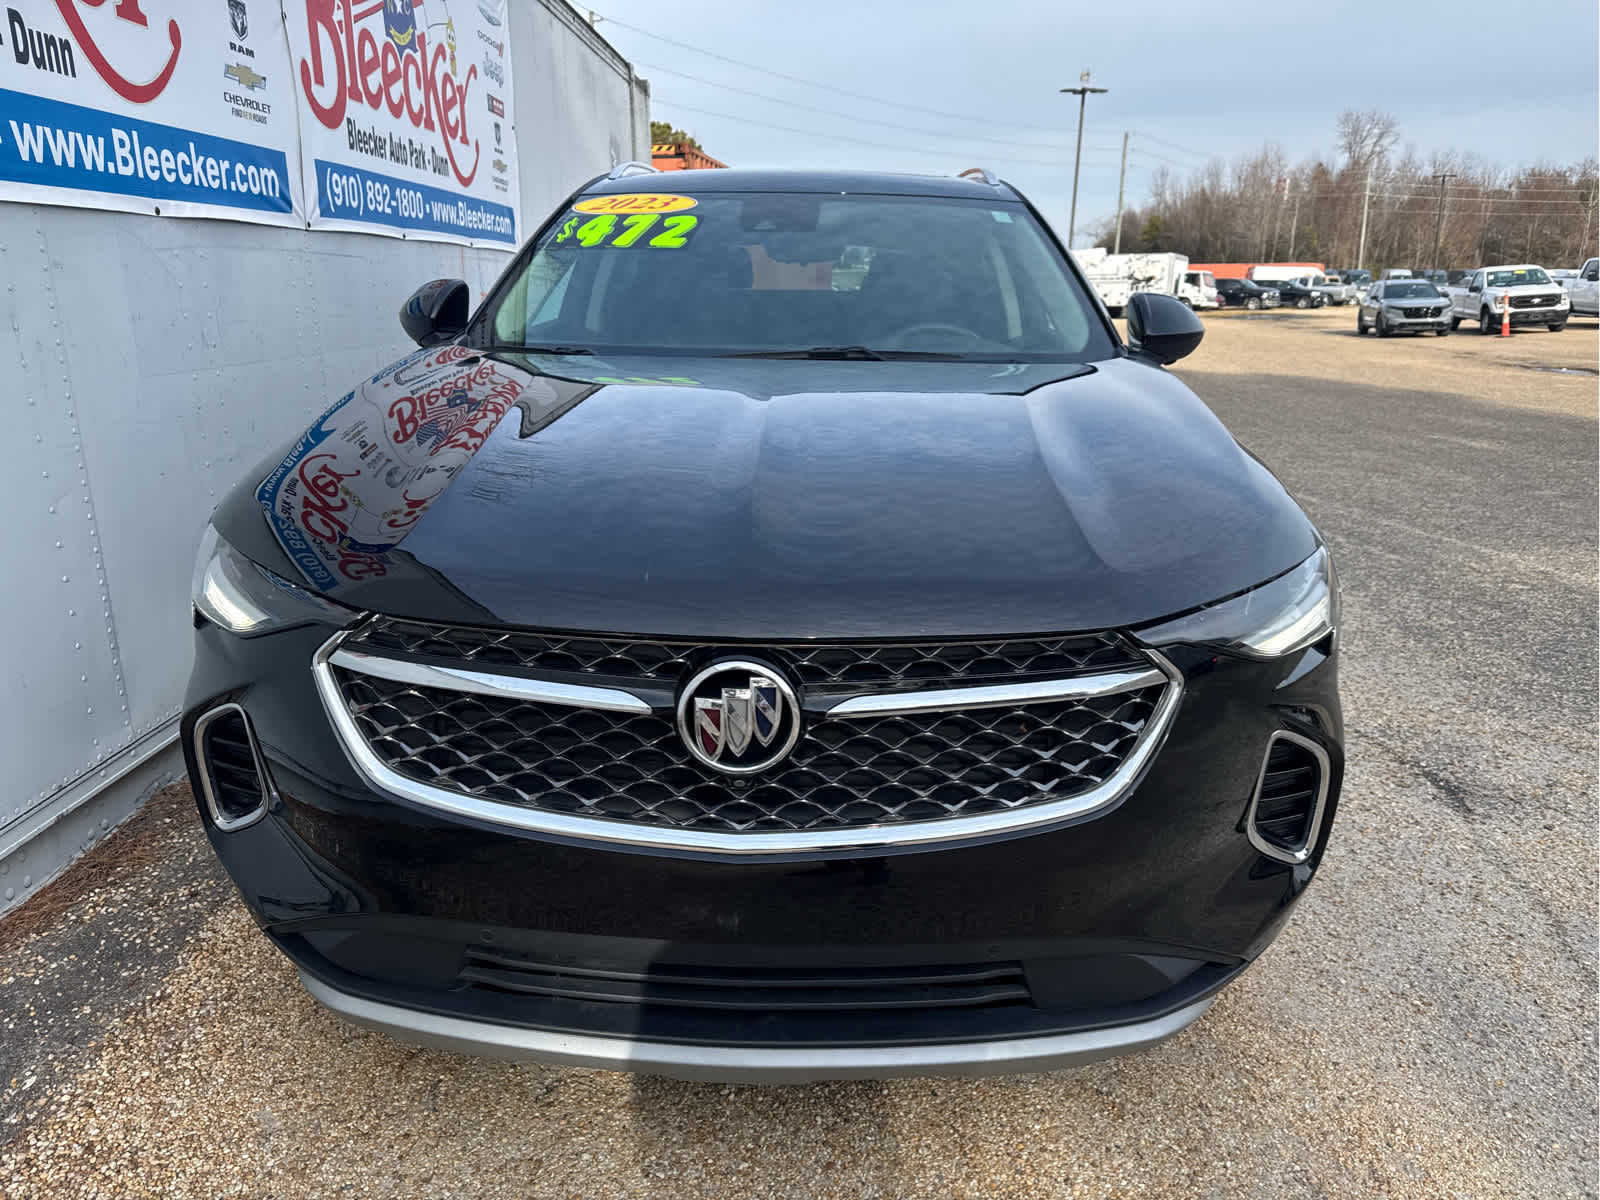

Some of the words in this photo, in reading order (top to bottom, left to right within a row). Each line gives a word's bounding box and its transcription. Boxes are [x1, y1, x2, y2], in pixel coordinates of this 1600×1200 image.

[7, 7, 76, 78] Dunn
[229, 41, 255, 58] RAM
[224, 92, 271, 114] CHEVROLET
[301, 0, 478, 187] Bleecker
[9, 120, 280, 197] www.Bleecker.com
[346, 117, 387, 160] Bleecker
[389, 131, 408, 166] Auto
[408, 138, 427, 171] Park
[431, 145, 450, 177] Dunn
[326, 167, 363, 217] (910)
[366, 180, 424, 219] 892-1800
[431, 201, 512, 234] www.Bleecker.com
[589, 197, 679, 210] 2023
[556, 214, 698, 248] $472
